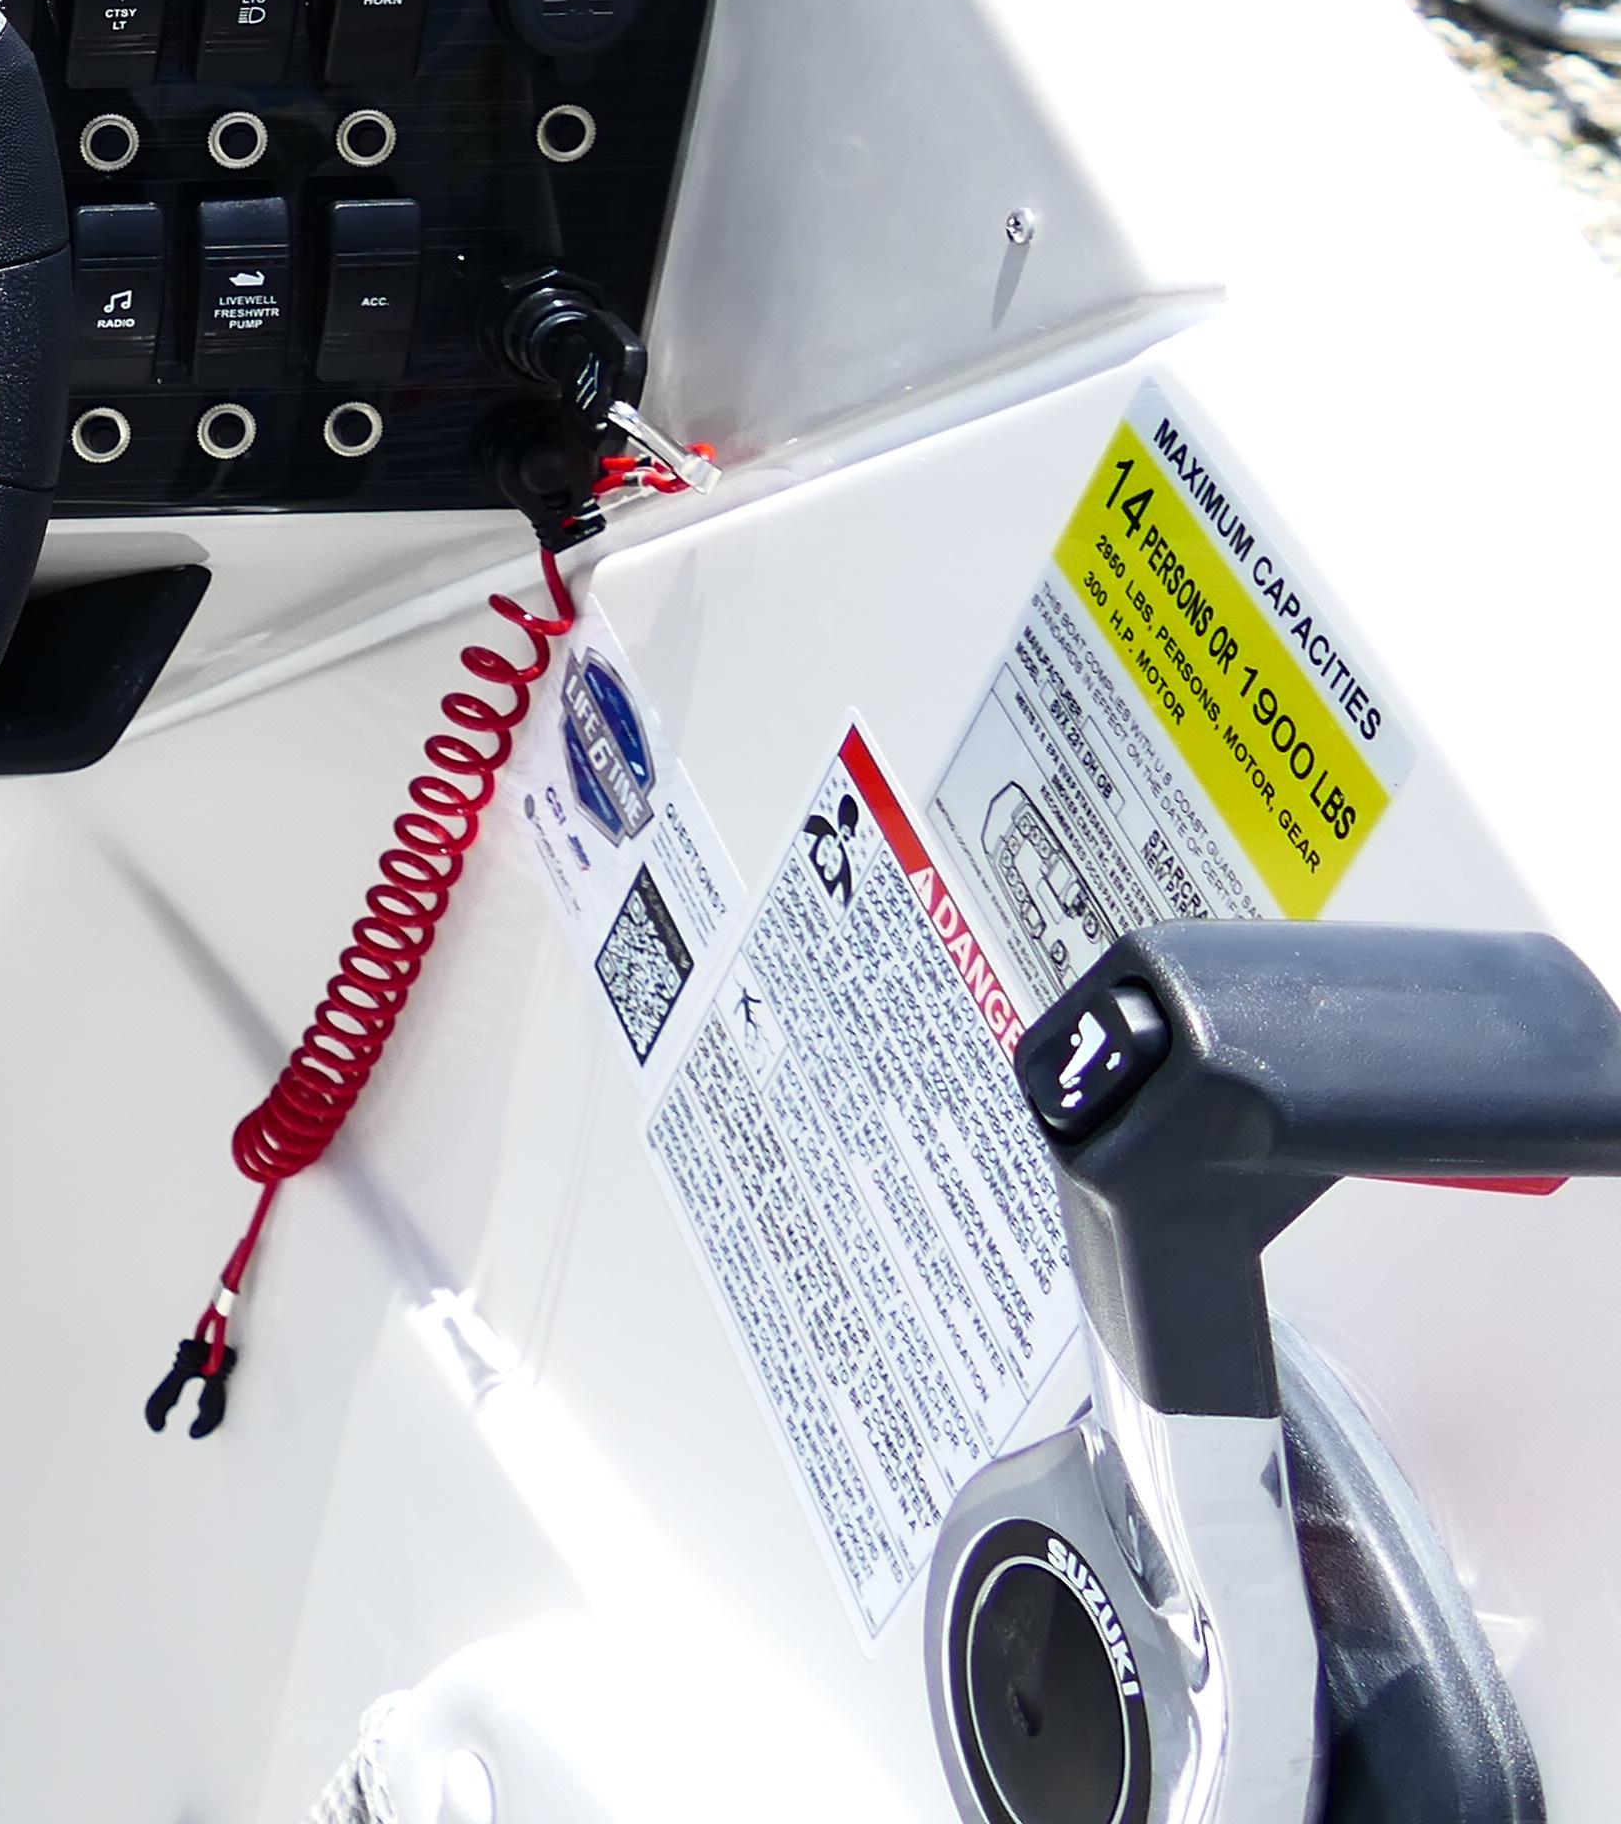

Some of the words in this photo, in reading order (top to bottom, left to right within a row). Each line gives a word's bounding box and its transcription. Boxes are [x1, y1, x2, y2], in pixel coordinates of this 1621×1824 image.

[105, 8, 137, 19] CTSY
[112, 21, 127, 30] LT
[97, 318, 135, 328] RADIO
[214, 307, 280, 318] FRESHWTR
[219, 296, 277, 306] LIVEWELL
[229, 319, 263, 329] PUMP
[361, 297, 391, 307] ACC.
[1083, 569, 1108, 608] 300
[1109, 609, 1135, 653] H.P.
[1135, 648, 1185, 726] MOTOR
[1103, 455, 1155, 540] 14
[1139, 523, 1214, 638] PERSONS
[1207, 623, 1239, 675] OR
[1237, 663, 1316, 782] 1900
[1309, 769, 1356, 841] LBS
[1153, 417, 1255, 562] MAXIMUM
[1252, 555, 1382, 742] CAPACITIES
[565, 673, 599, 742] LIFE
[588, 733, 613, 774] 6
[608, 756, 643, 830] TIME
[1032, 593, 1083, 676] STANDARDS
[1082, 672, 1094, 691] IN
[1092, 687, 1128, 741] EFFECT
[1127, 742, 1142, 768] ON
[1143, 765, 1162, 799] THE
[1160, 795, 1187, 838] DATE
[1186, 836, 1203, 859] OF
[1043, 581, 1062, 615] THIS
[1060, 612, 1086, 649] BOAT
[1084, 649, 1131, 723] COMPLIES
[1129, 719, 1155, 759] WITH
[1173, 787, 1208, 837] COAST
[1206, 839, 1243, 897] GUARD
[1082, 750, 1098, 776] DH
[1095, 533, 1126, 580] 2950
[1125, 578, 1155, 632] LBS,
[1155, 624, 1222, 731] PERSONS,
[1222, 725, 1277, 813] MOTOR,
[1277, 807, 1321, 874] GEAR
[665, 799, 726, 919] QUESTIONS?
[880, 849, 915, 914] CARBON
[914, 912, 959, 994] MONOXIDE
[976, 1026, 996, 1063] CAN
[931, 893, 1025, 1060] DANGE
[975, 1085, 1013, 1157] CARBON
[1011, 1155, 1061, 1245] MONOXIDE
[1016, 1200, 1058, 1276] INCLUDE
[1046, 1534, 1141, 1699] SUZUKI
